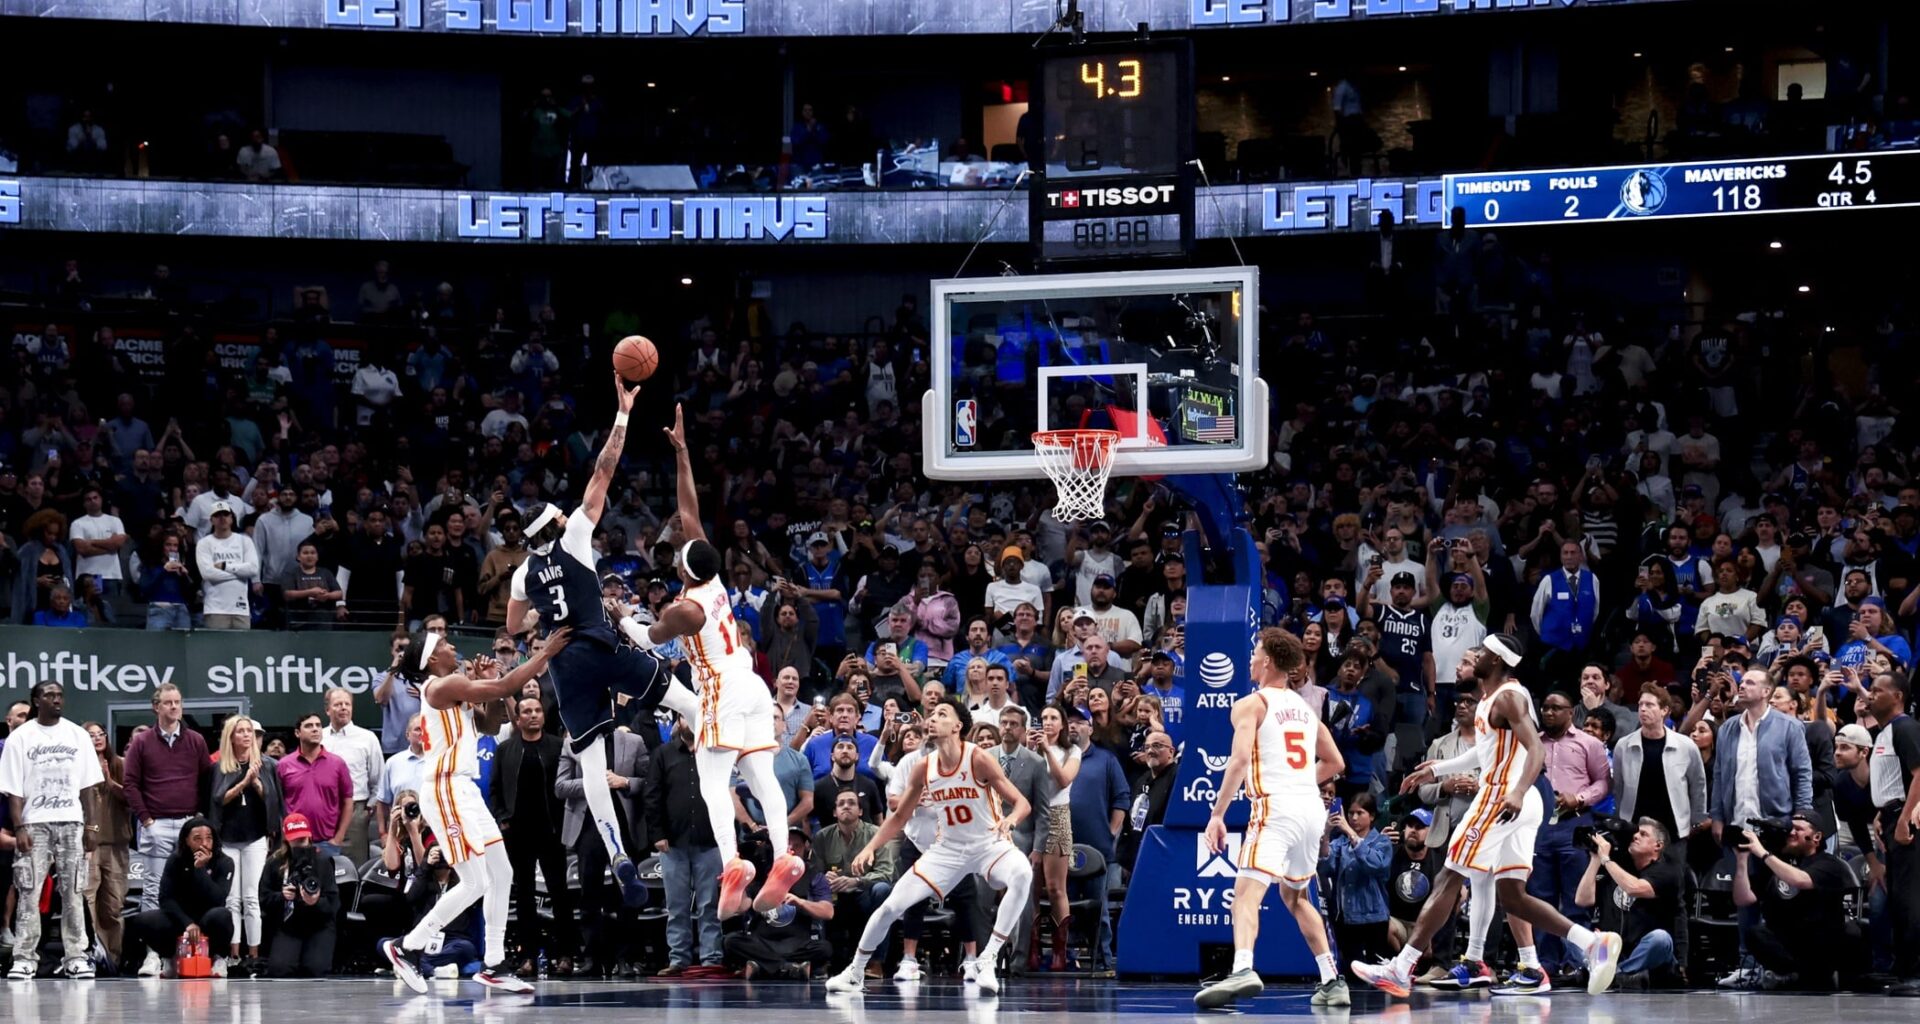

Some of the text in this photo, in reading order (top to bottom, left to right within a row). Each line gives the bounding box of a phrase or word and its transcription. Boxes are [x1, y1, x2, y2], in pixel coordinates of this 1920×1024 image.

[496, 0, 567, 32] GO
[581, 0, 744, 36] MAVS
[1082, 60, 1141, 99] 4.3
[1550, 177, 1598, 190] FOULS
[1685, 165, 1787, 183] MAVERICKS
[1828, 161, 1872, 185] 4.5
[1081, 185, 1175, 207] TISSOT
[1456, 180, 1531, 194] TIMEOUTS
[1263, 179, 1403, 230] LET'S
[1564, 196, 1580, 217] 2
[1713, 185, 1761, 211] 118
[1817, 190, 1876, 207] QTR 4
[458, 193, 826, 242] LET'S GO MAVS
[1484, 200, 1500, 221] 0
[114, 338, 163, 351] ACME
[127, 353, 165, 365] RICK
[538, 565, 563, 584] DAVIS
[549, 585, 569, 621] 3
[1383, 620, 1420, 637] MAVS
[1443, 625, 1459, 638] 31
[1401, 638, 1418, 656] 25
[0, 651, 174, 693] hiftkey
[1196, 693, 1238, 708] AT&T
[1275, 708, 1309, 725] DANIELS
[1284, 731, 1307, 769] 5
[944, 804, 974, 826] 10
[1174, 887, 1236, 909] RYS
[1178, 914, 1218, 925] ENERGY
